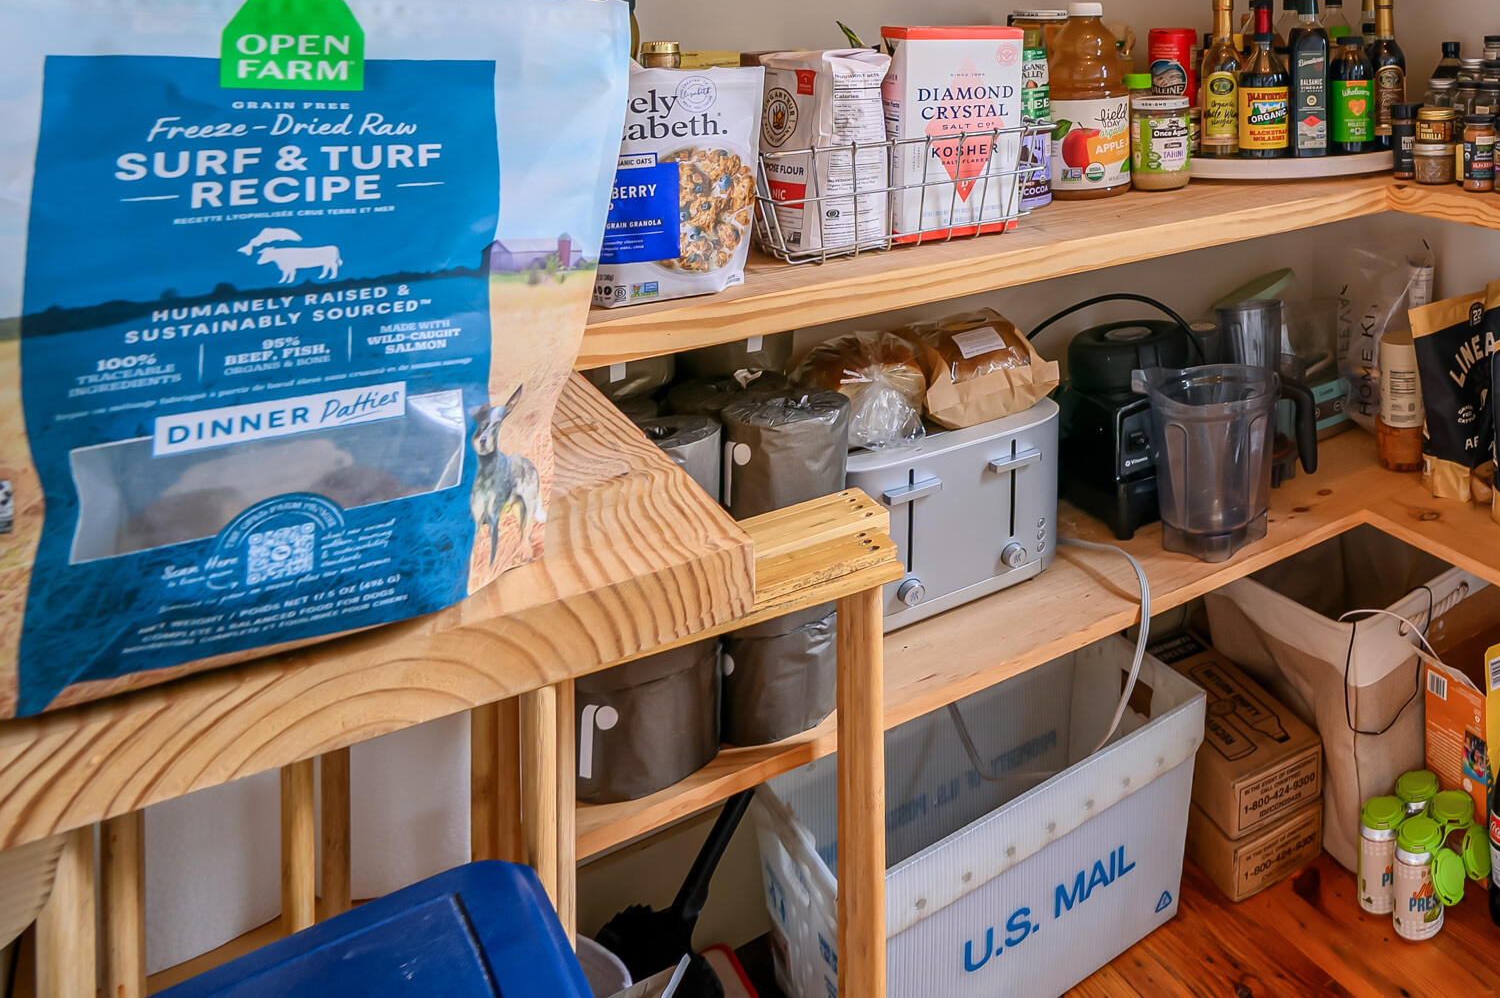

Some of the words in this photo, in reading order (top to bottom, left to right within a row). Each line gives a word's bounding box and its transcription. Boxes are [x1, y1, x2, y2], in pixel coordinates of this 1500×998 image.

[236, 34, 350, 56] OPEN
[237, 59, 349, 82] FARM
[628, 89, 678, 118] ely
[918, 85, 1014, 102] DIAMOND
[232, 101, 296, 110] GRAIN
[303, 101, 350, 110] FREE
[921, 103, 1009, 120] CRYSTAL
[1094, 103, 1128, 128] field
[1251, 108, 1287, 123] ORGANIC
[359, 113, 418, 137] Raw
[622, 113, 728, 141] abeth.
[1106, 119, 1121, 127] DAY
[931, 143, 999, 159] KOSHER
[1095, 140, 1125, 154] APPLE
[115, 147, 263, 181] SURF
[275, 145, 308, 172] &
[320, 143, 443, 172] TURF
[780, 165, 804, 176] FLOUR
[190, 174, 382, 209] RECIPE
[611, 184, 657, 199] BERRY
[1024, 185, 1048, 196] COCOA
[173, 214, 223, 225] RECETTE
[297, 208, 325, 218] CRUE
[327, 207, 358, 216] TERRE
[360, 206, 372, 214] ET
[374, 205, 396, 213] MER
[629, 219, 662, 228] GRANOLA
[151, 295, 294, 323] HUMANELY
[304, 285, 388, 306] RAISED
[397, 284, 410, 296] &
[1472, 309, 1482, 321] 22
[124, 311, 301, 344] SUSTAINABLY
[366, 328, 461, 347] WILD-CAUGHT
[379, 322, 413, 334] MADE
[416, 319, 450, 330] WITH
[262, 335, 300, 351] 95%
[384, 339, 447, 354] SALMON
[97, 353, 158, 372] 100%
[224, 361, 279, 376] ORGANS
[284, 359, 294, 368] &
[296, 354, 331, 366] BONE
[76, 363, 176, 385] TRACEABLE
[68, 373, 182, 398] INGREDIENTS
[167, 405, 310, 445] DINNER
[320, 388, 400, 424] Patties
[283, 595, 309, 609] NET
[338, 585, 357, 595] OZ
[299, 602, 333, 616] FOOD
[336, 596, 360, 608] FOR
[362, 589, 395, 602] DOGS
[1234, 690, 1262, 717] EMPTY
[1243, 772, 1317, 815] 1-800-424-9300
[964, 907, 1039, 973] U.S.
[1054, 844, 1136, 919] MAIL
